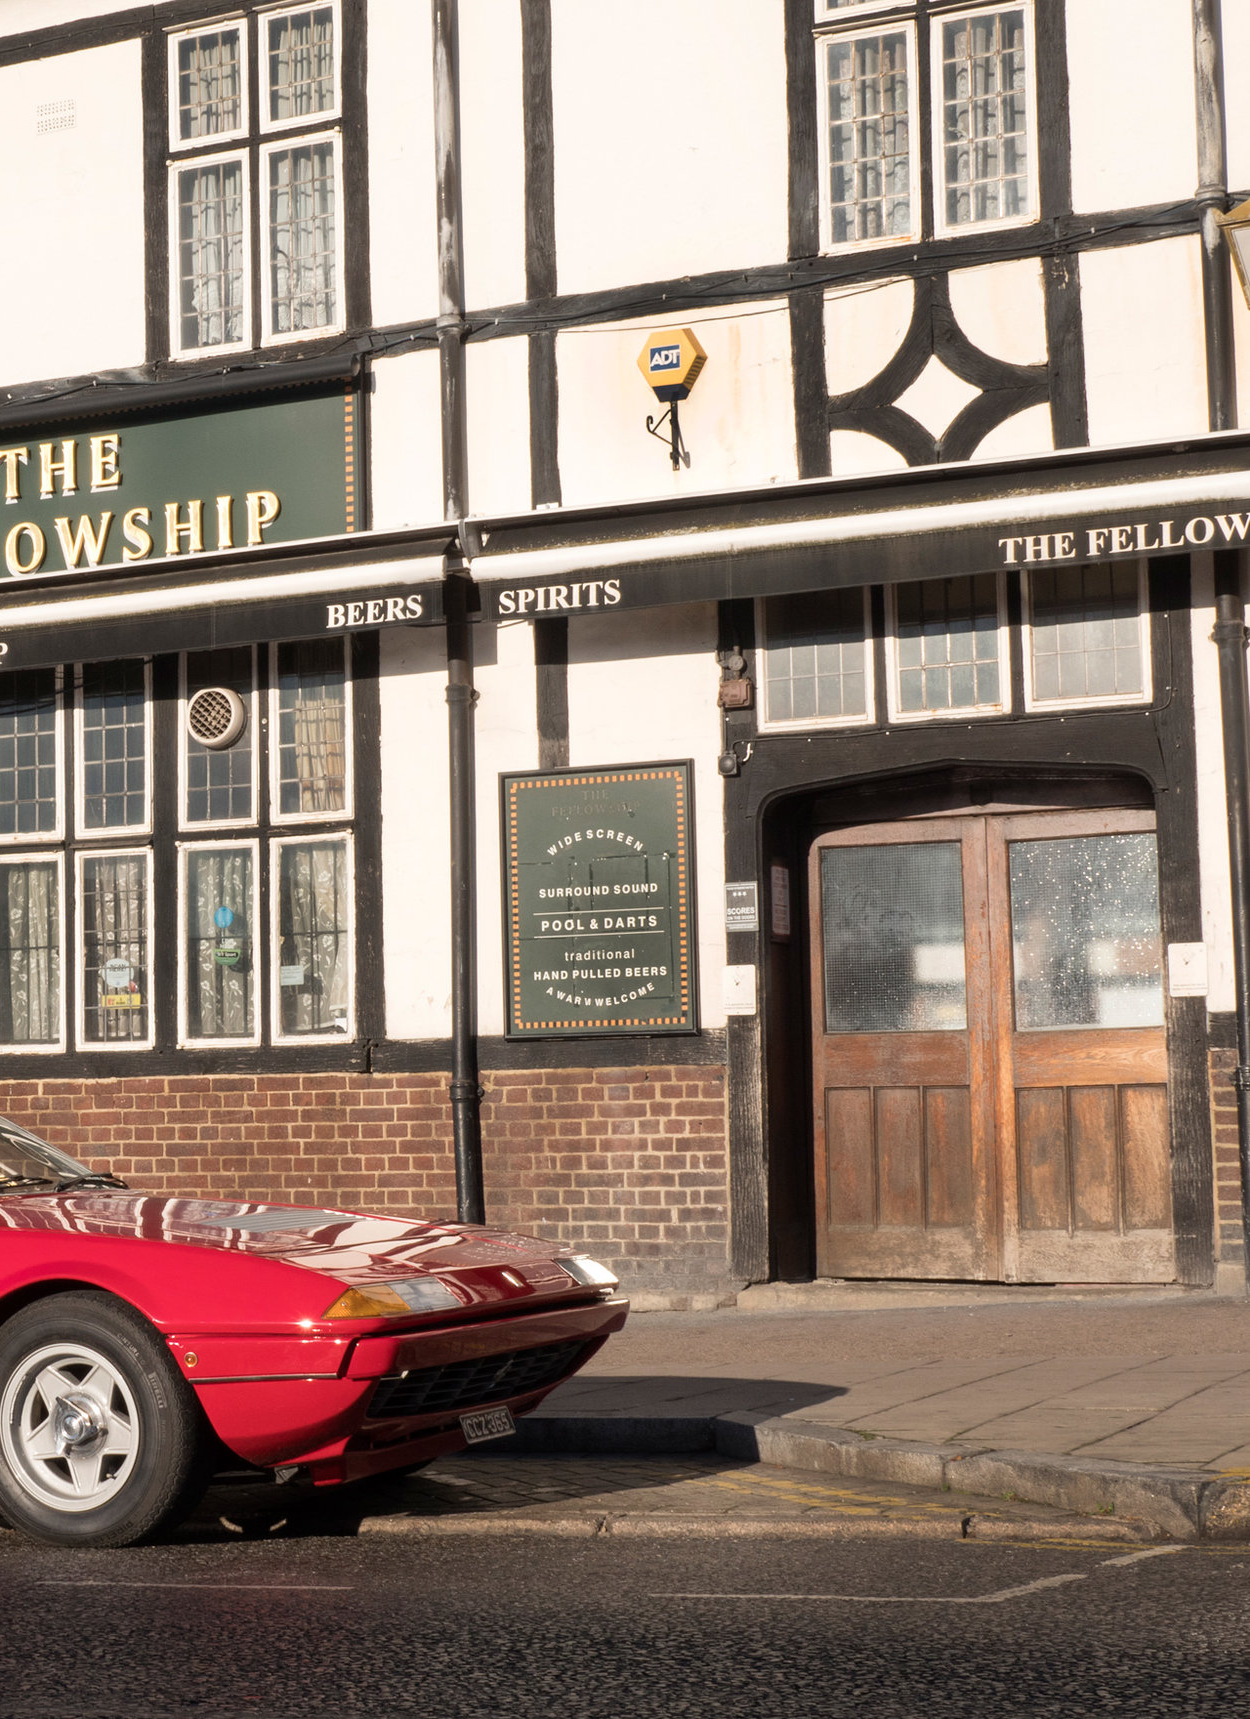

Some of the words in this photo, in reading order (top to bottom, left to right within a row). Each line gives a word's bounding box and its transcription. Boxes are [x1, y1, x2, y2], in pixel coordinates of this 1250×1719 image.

[651, 349, 680, 367] ADT
[998, 531, 1076, 564] THE
[498, 579, 621, 615] SPIRITS
[326, 594, 422, 629] BEERS
[547, 831, 582, 856] WIDE
[586, 829, 643, 852] SCREEN
[538, 885, 610, 898] SURROUND
[613, 883, 658, 895] SOUND
[727, 906, 755, 915] SCORES
[541, 918, 584, 931] POOL
[590, 918, 599, 930] &
[604, 915, 658, 929] DARTS
[564, 948, 635, 961] traditional
[533, 970, 568, 981] HAND
[572, 968, 621, 979] PULLED
[625, 966, 667, 977] BEERS
[546, 986, 554, 996] A
[556, 990, 591, 1006] WARM
[594, 982, 655, 1007] WELCOME
[148, 1371, 166, 1409] PIRELLI
